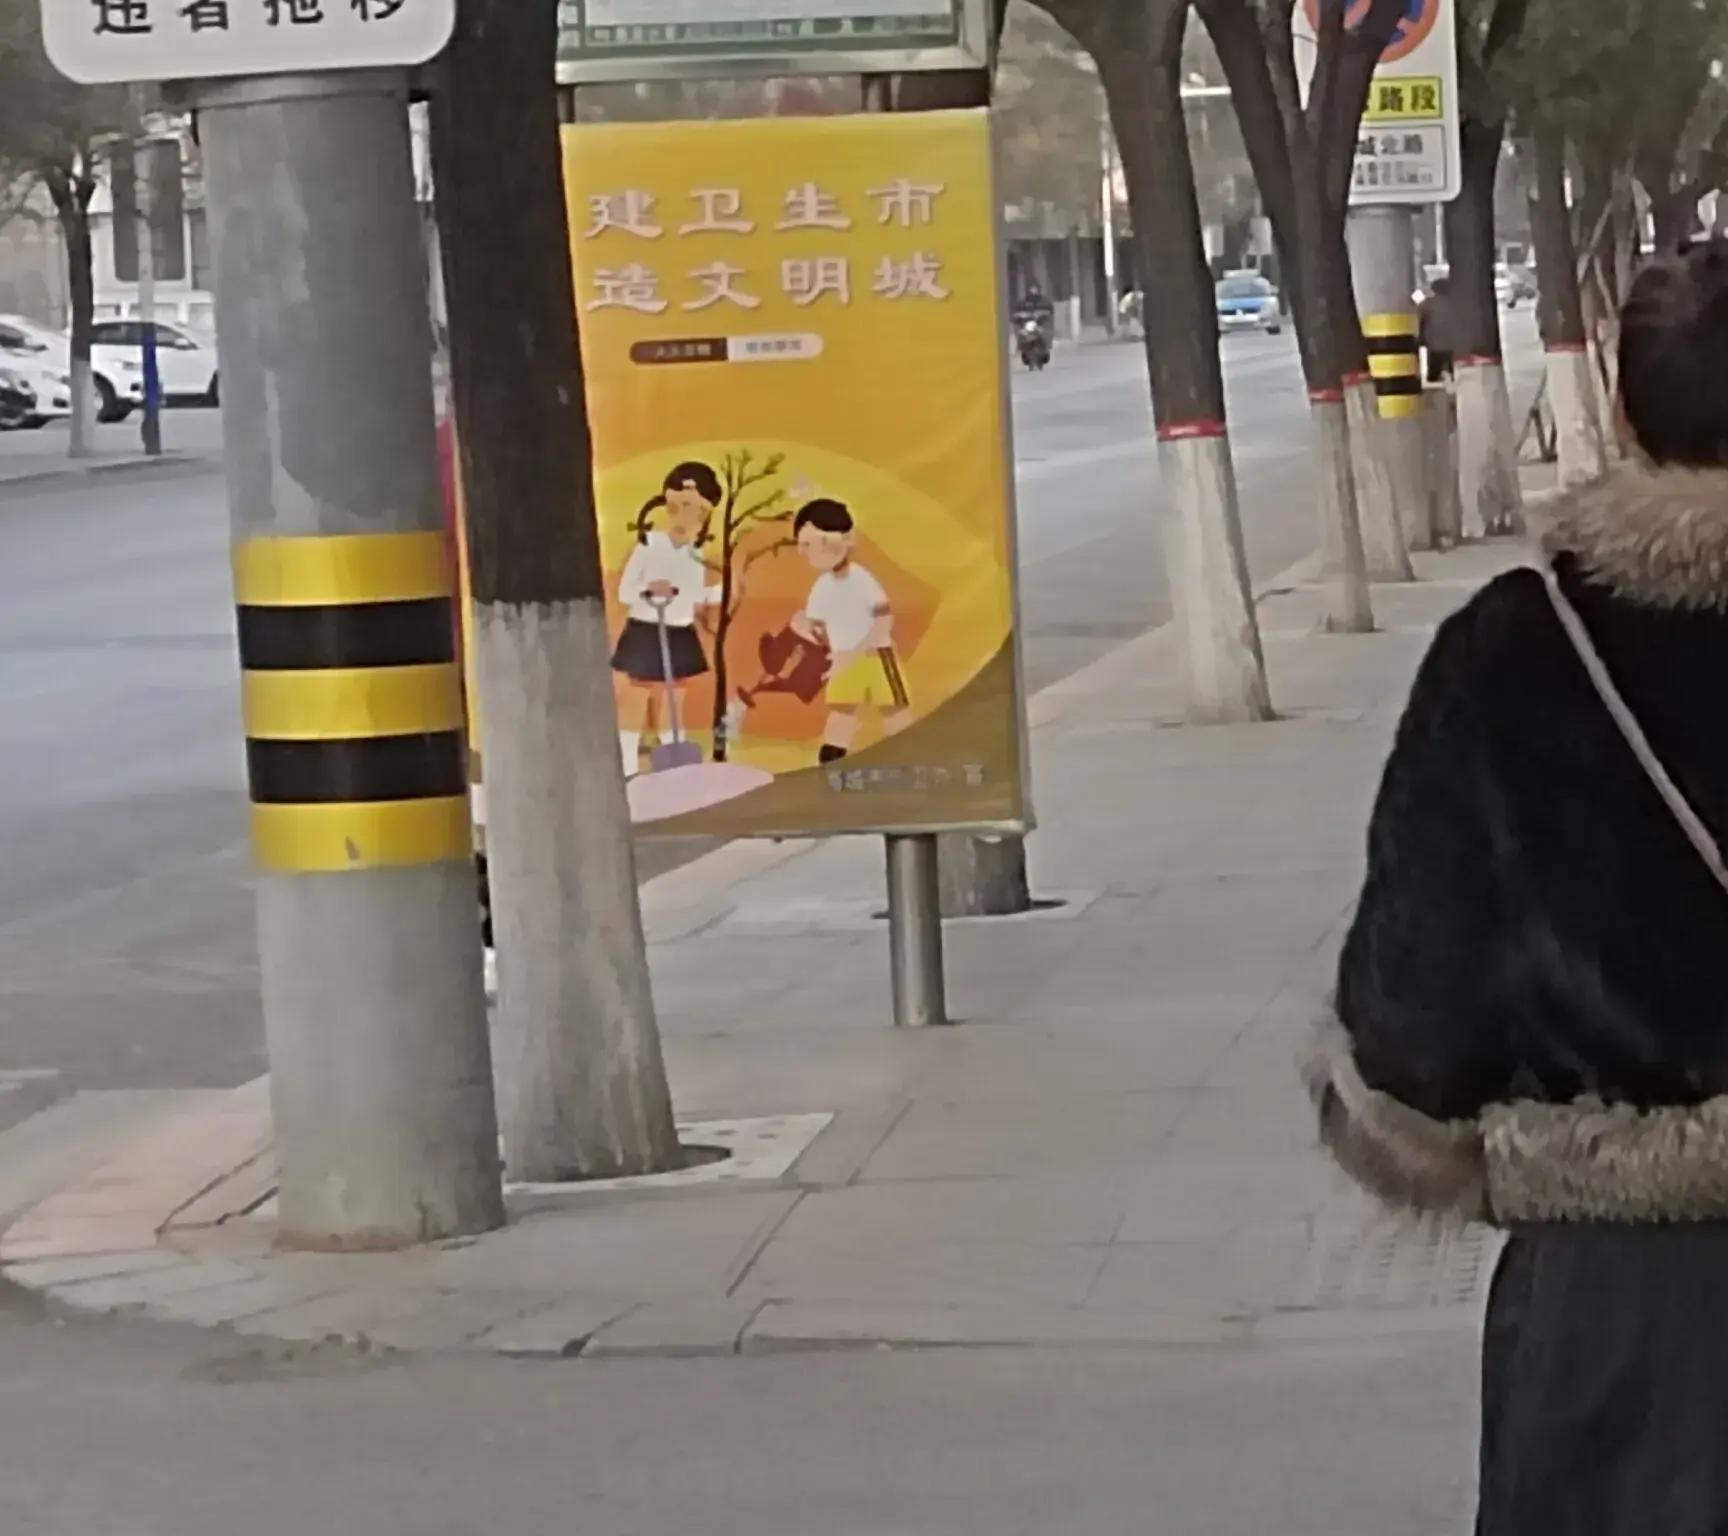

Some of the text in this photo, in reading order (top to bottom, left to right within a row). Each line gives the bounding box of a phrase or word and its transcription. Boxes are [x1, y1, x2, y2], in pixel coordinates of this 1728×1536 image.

[1367, 84, 1436, 112] 路段
[584, 178, 945, 239] 建卫生市
[585, 251, 950, 314] 造文明城
